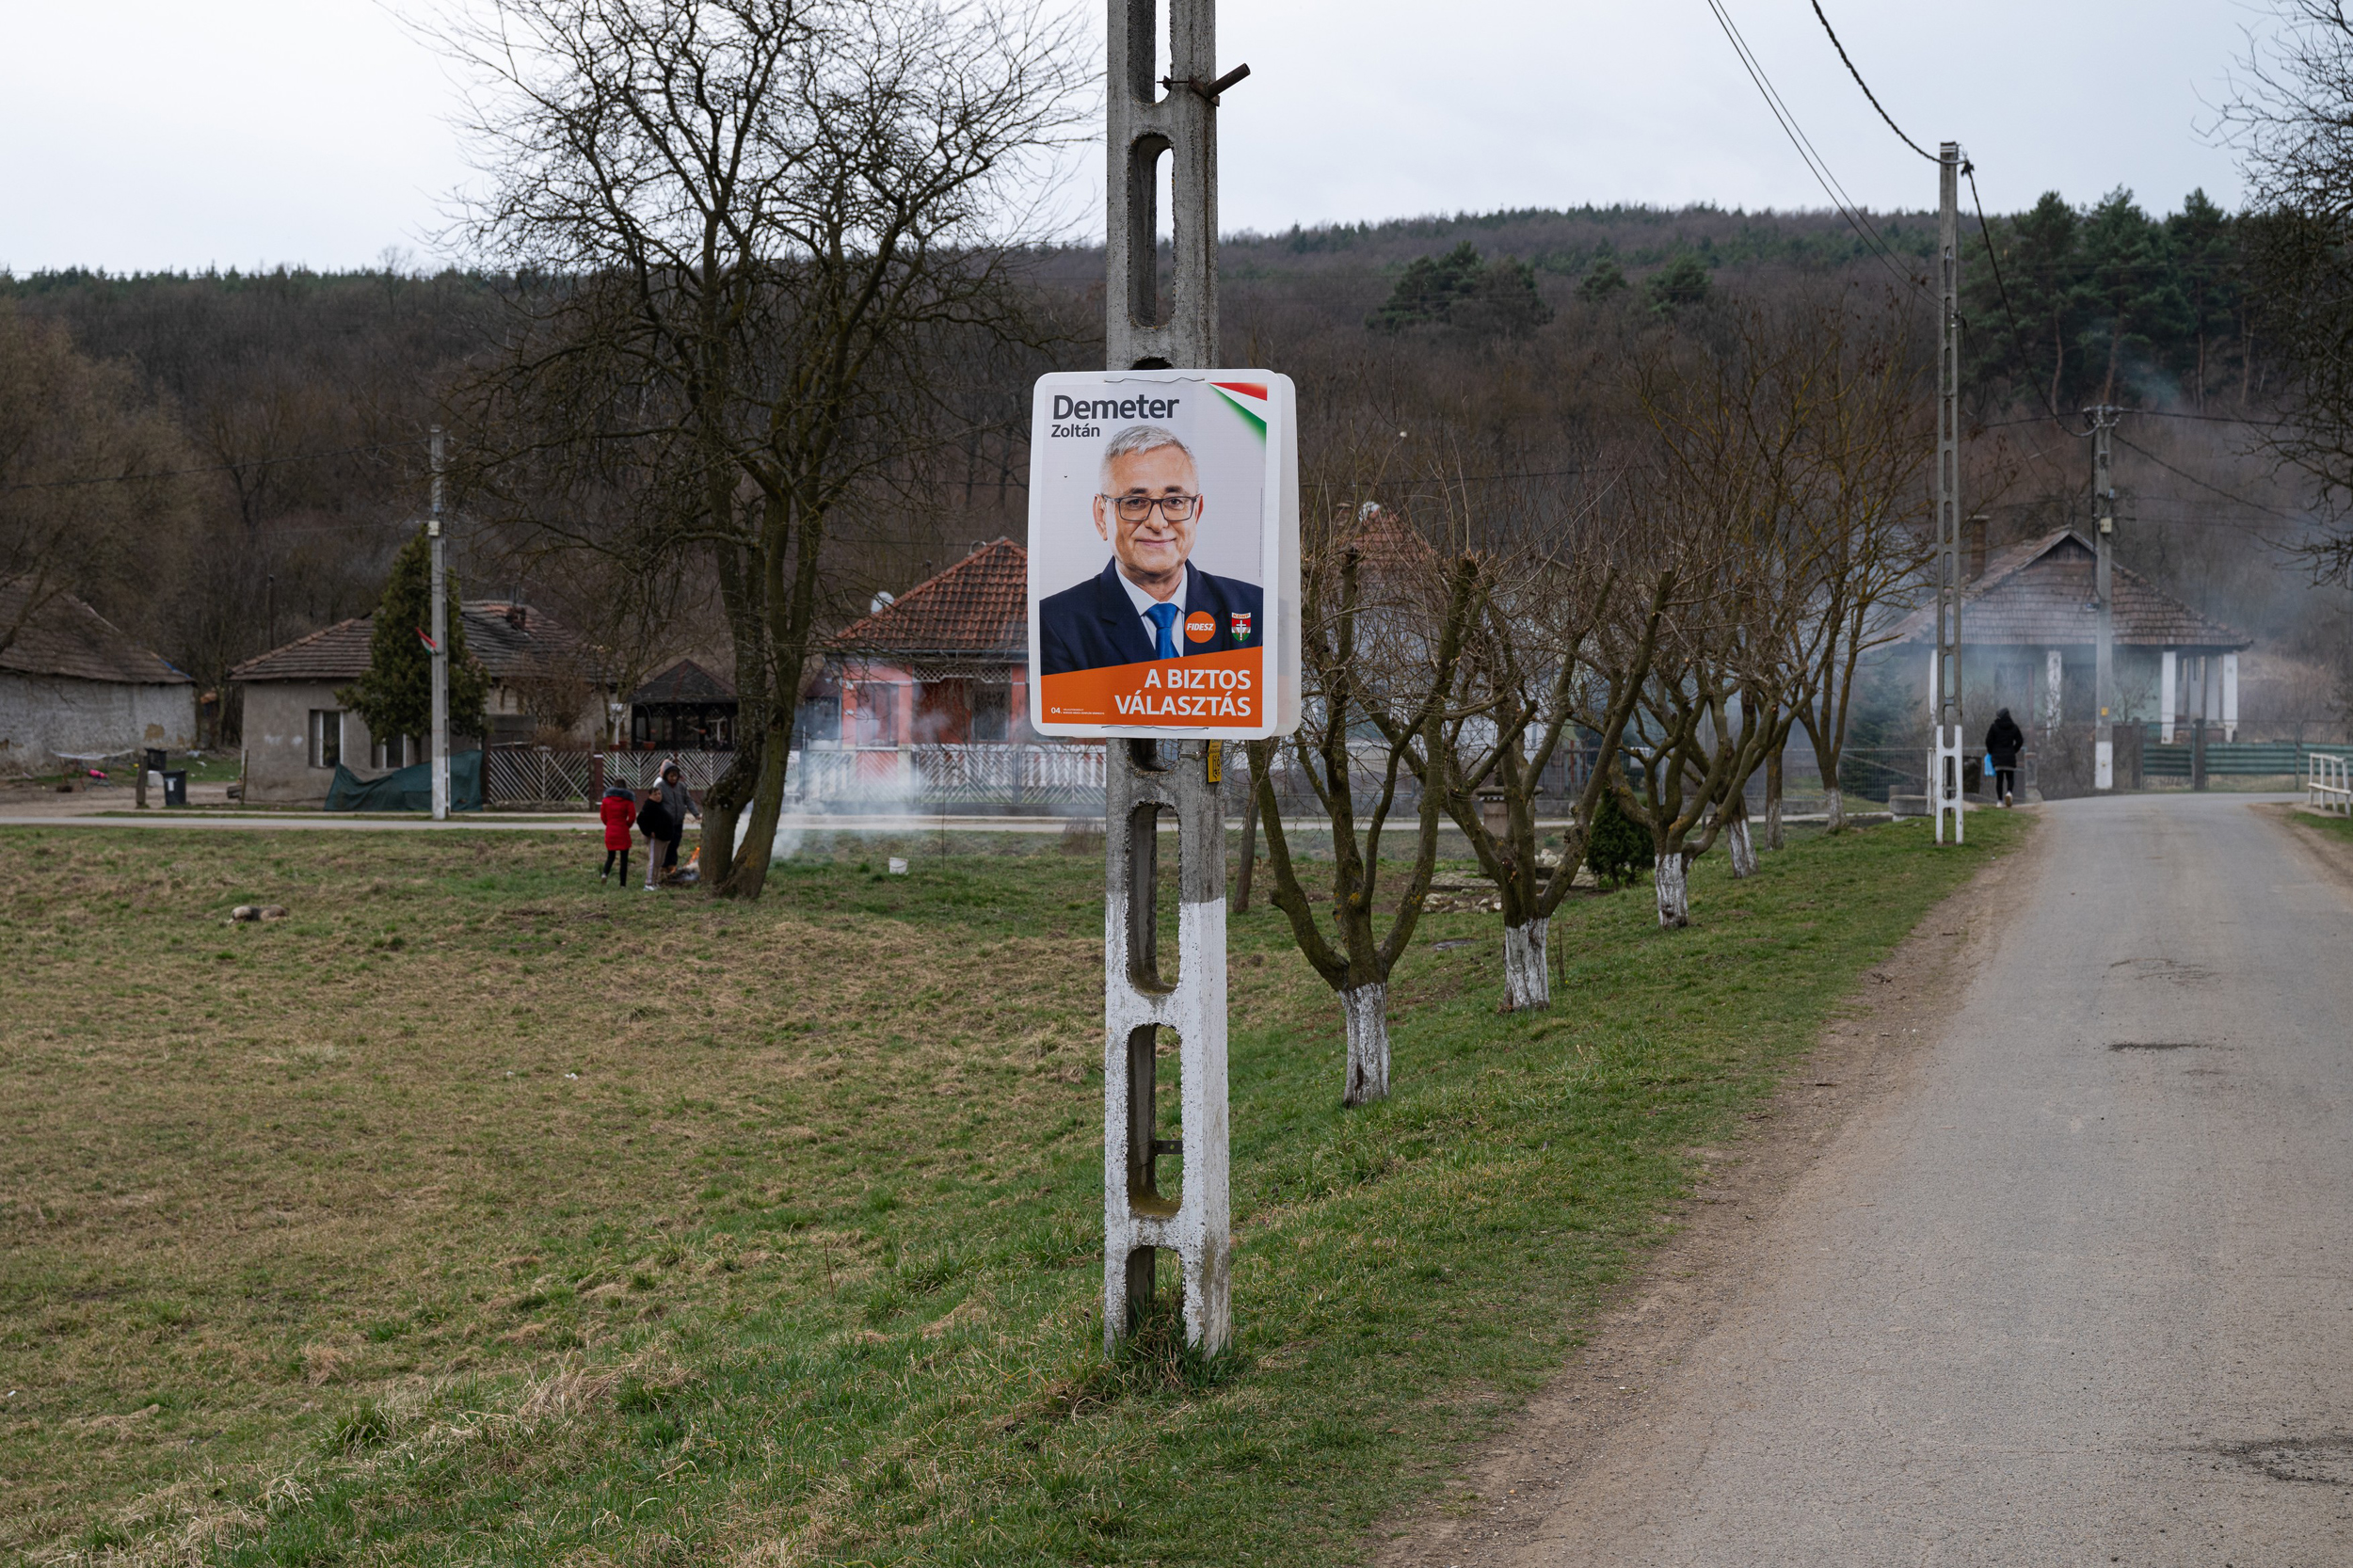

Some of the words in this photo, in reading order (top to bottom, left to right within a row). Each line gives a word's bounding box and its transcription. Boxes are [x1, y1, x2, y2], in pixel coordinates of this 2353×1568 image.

[1053, 394, 1179, 420] Demeter
[1051, 424, 1100, 438] Zoltán
[1187, 622, 1214, 631] FIDESZ
[1144, 668, 1161, 689] A
[1167, 669, 1252, 689] BIZTOS
[1114, 690, 1252, 717] VÁLASZTÁS
